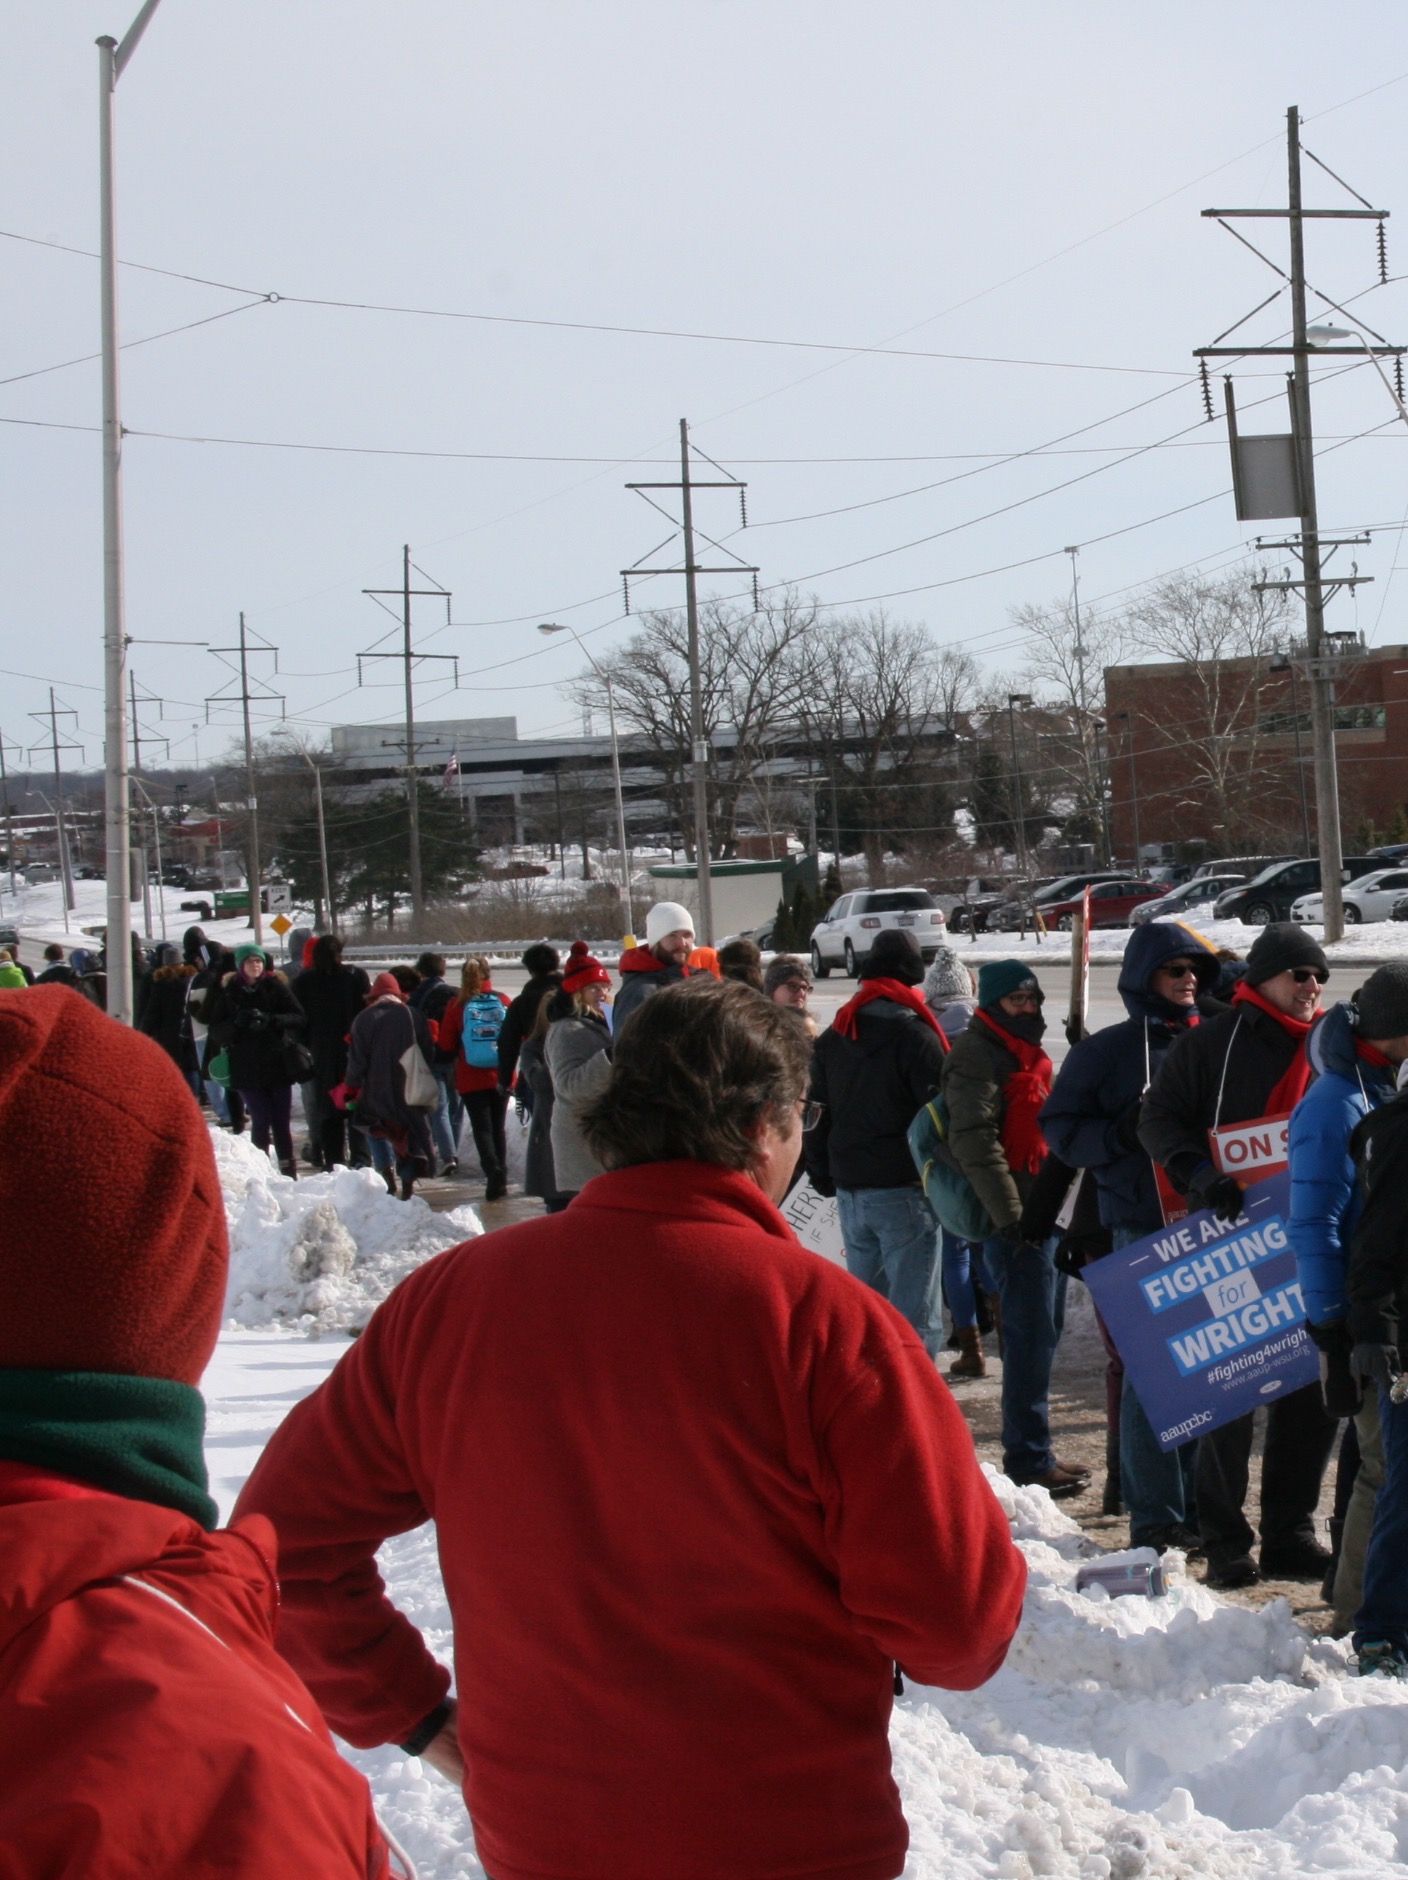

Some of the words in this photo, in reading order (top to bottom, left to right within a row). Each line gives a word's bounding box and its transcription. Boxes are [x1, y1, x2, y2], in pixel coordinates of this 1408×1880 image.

[1224, 1133, 1273, 1164] ON
[785, 1183, 824, 1231] HER
[1144, 1222, 1288, 1308] FIGHTING
[1152, 1228, 1198, 1262] WE
[1218, 1281, 1247, 1308] for
[1171, 1283, 1307, 1369] WRIGHT
[1207, 1328, 1311, 1385] #fighting4wrigh
[1221, 1345, 1311, 1391] www.aaup-wsu.org
